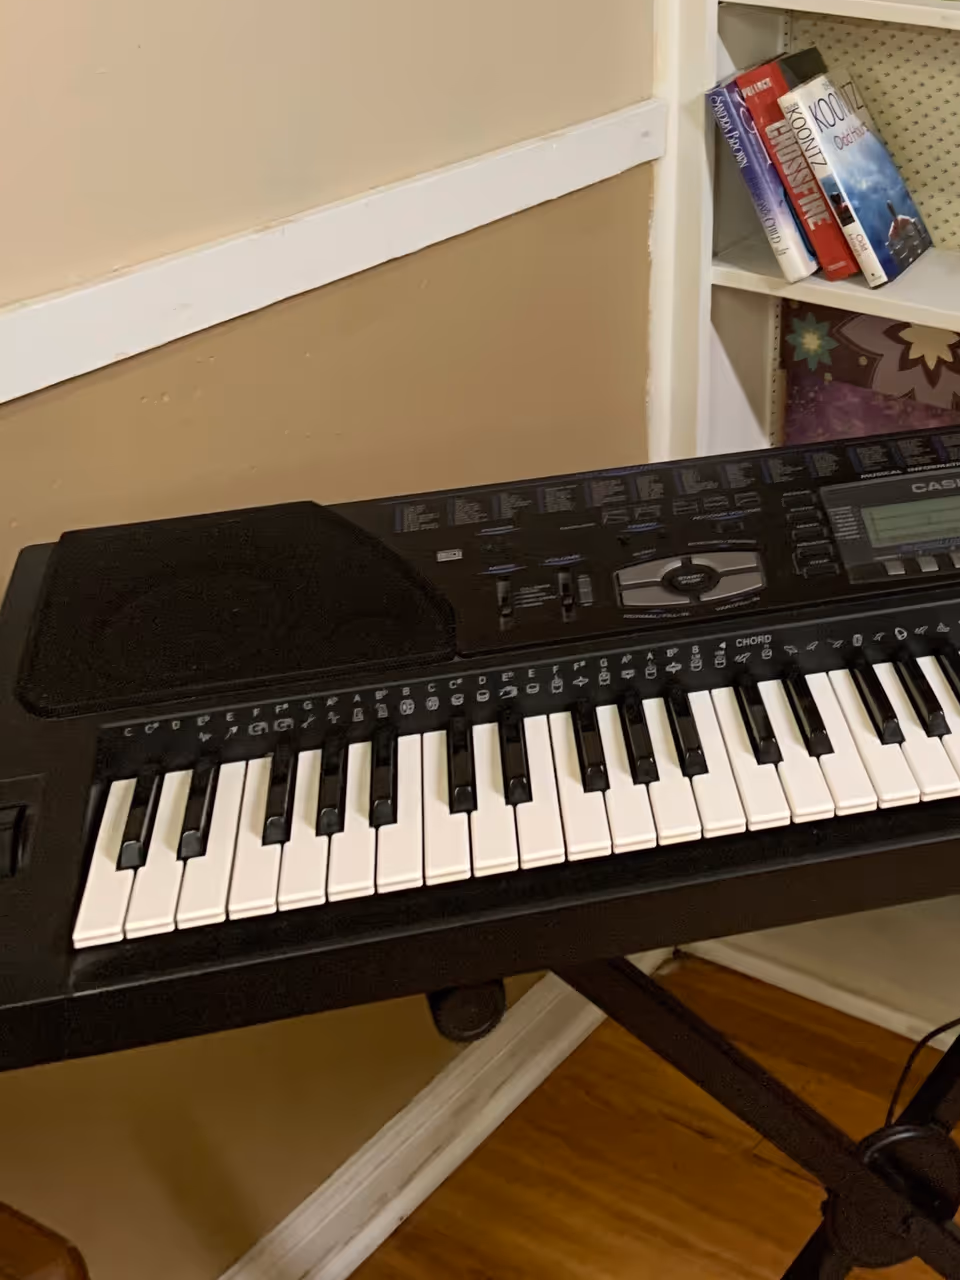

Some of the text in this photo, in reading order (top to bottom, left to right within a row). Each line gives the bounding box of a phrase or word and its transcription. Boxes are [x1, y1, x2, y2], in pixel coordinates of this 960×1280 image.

[808, 81, 865, 134] KOONTZ
[710, 94, 750, 169] SANDRA BROWN
[786, 106, 828, 167] KOONTZ
[833, 131, 853, 151] Odd
[764, 119, 832, 231] CROSSFIRE
[762, 213, 782, 245] CHILD
[854, 233, 870, 252] Odd
[860, 468, 904, 480] MUSICAL
[735, 634, 773, 648] CHORD
